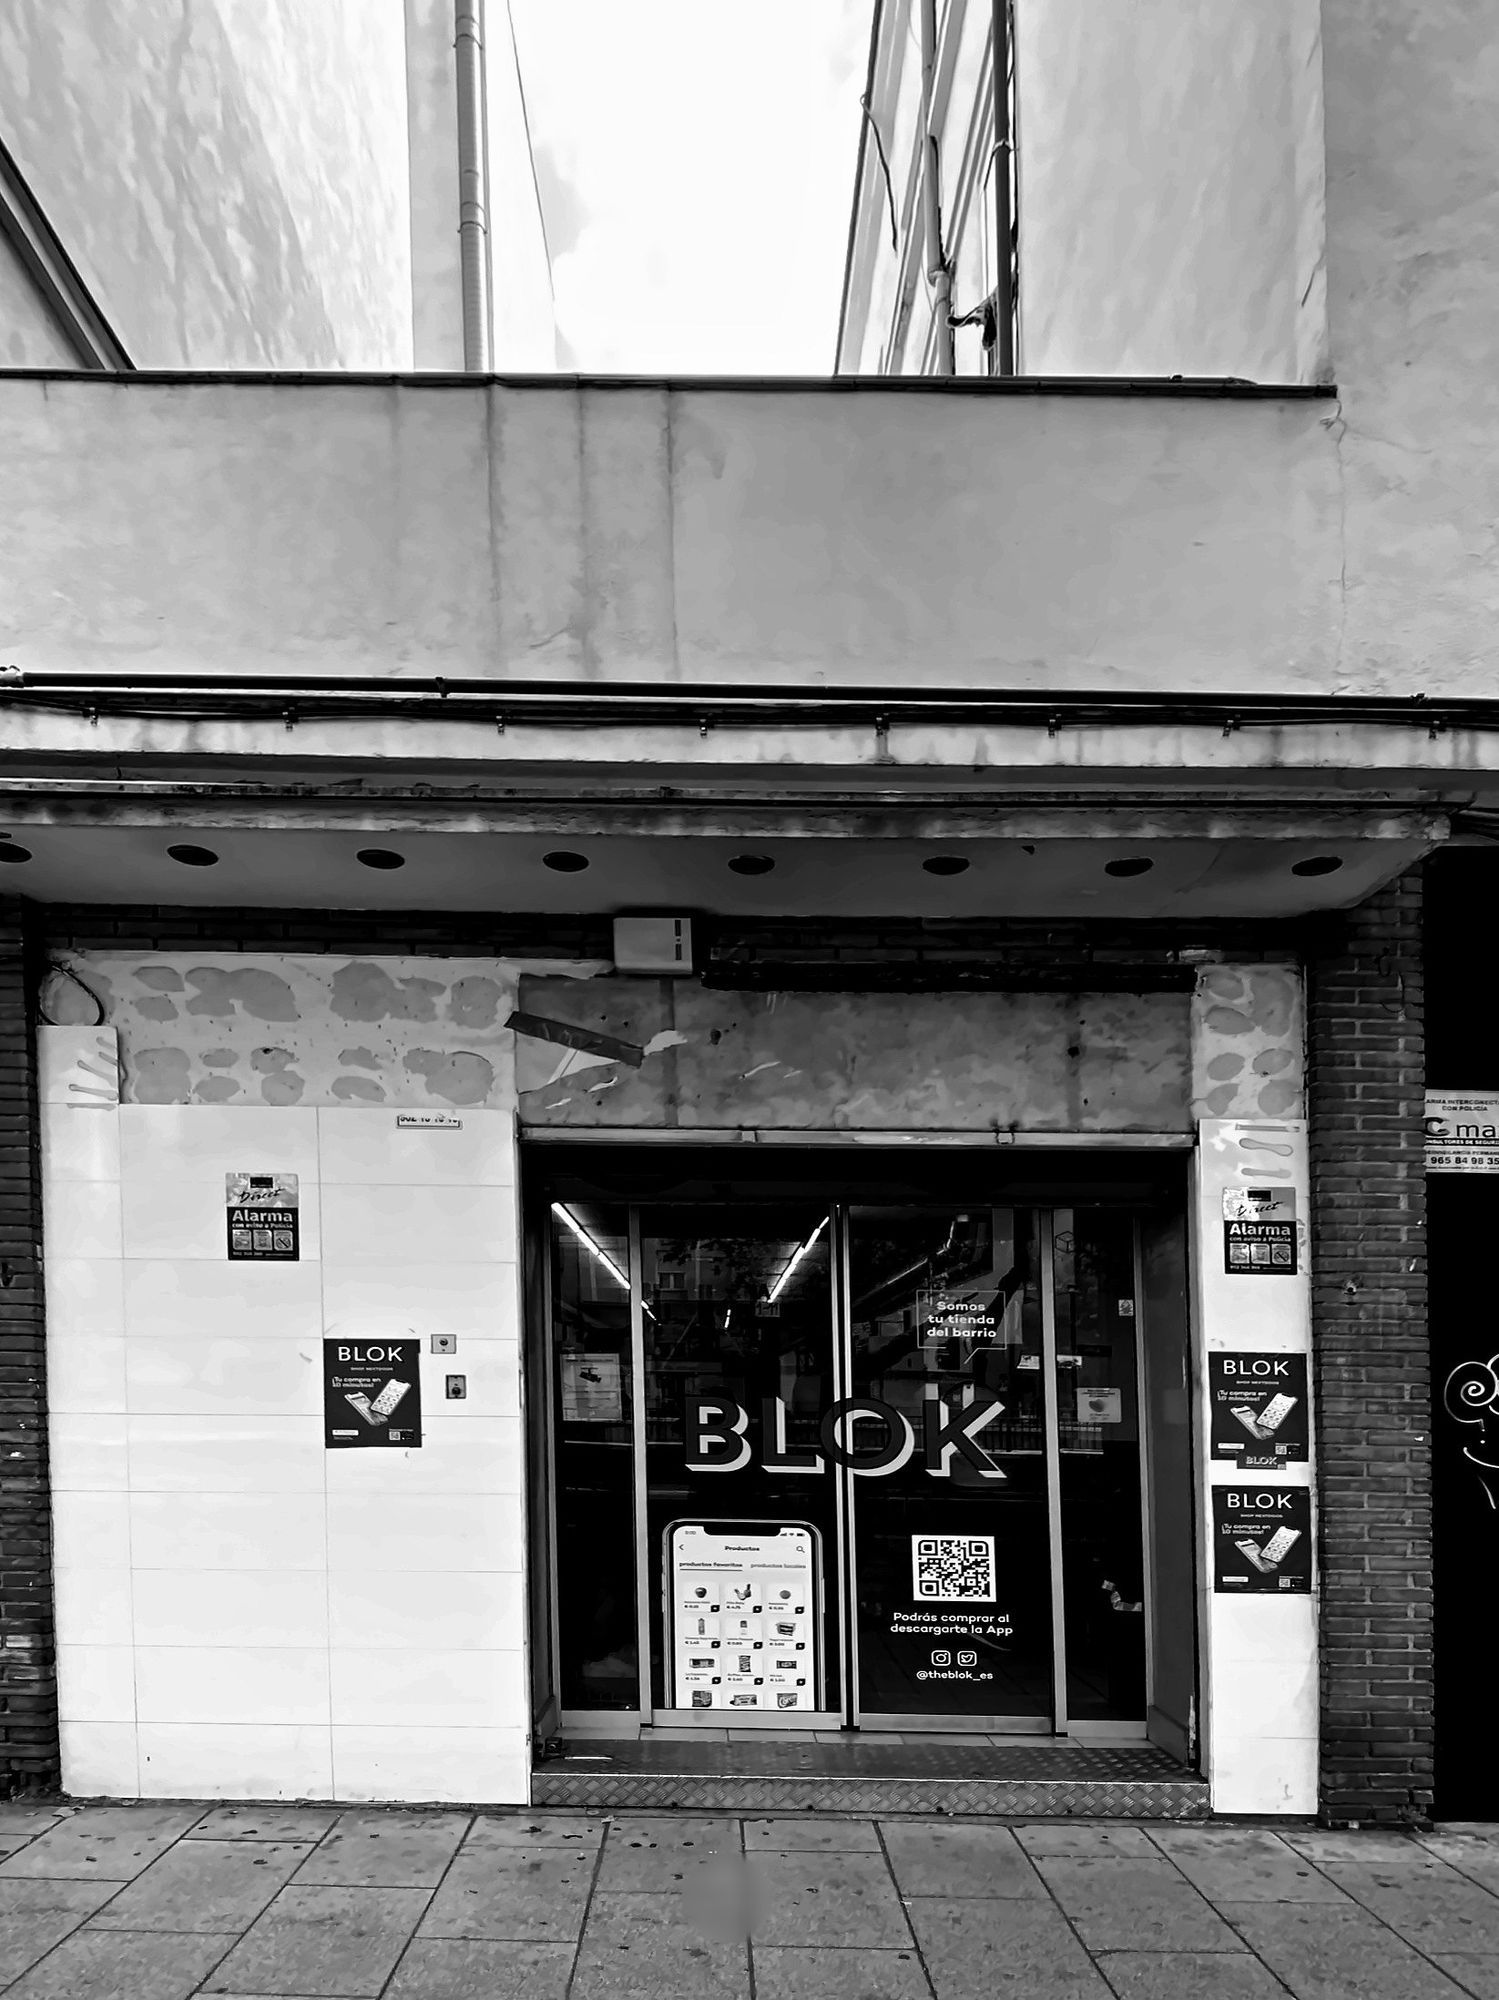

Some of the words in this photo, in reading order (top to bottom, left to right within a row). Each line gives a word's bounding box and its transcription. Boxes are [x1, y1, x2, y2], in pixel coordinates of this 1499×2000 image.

[1430, 1156, 1451, 1164] 965
[1454, 1156, 1468, 1164] 84
[1471, 1157, 1484, 1165] 98
[232, 1209, 293, 1222] Alarma
[1229, 1223, 1291, 1236] Alarma
[936, 1301, 986, 1311] Somos
[928, 1314, 944, 1324] tu
[948, 1314, 995, 1324] tienda
[926, 1327, 949, 1337] del
[952, 1327, 997, 1338] barrio
[338, 1346, 403, 1362] BLOK
[1223, 1359, 1289, 1376] BLOK
[685, 1396, 1007, 1478] BLOK
[1246, 1456, 1278, 1465] BLOK
[1227, 1492, 1293, 1509] BLOK
[893, 1612, 938, 1622] Podrás
[940, 1615, 995, 1625] comprar
[997, 1614, 1010, 1623] al
[890, 1623, 968, 1636] descargarte
[971, 1624, 983, 1634] la
[986, 1625, 1014, 1637] App
[916, 1670, 994, 1681] @theblok_es
